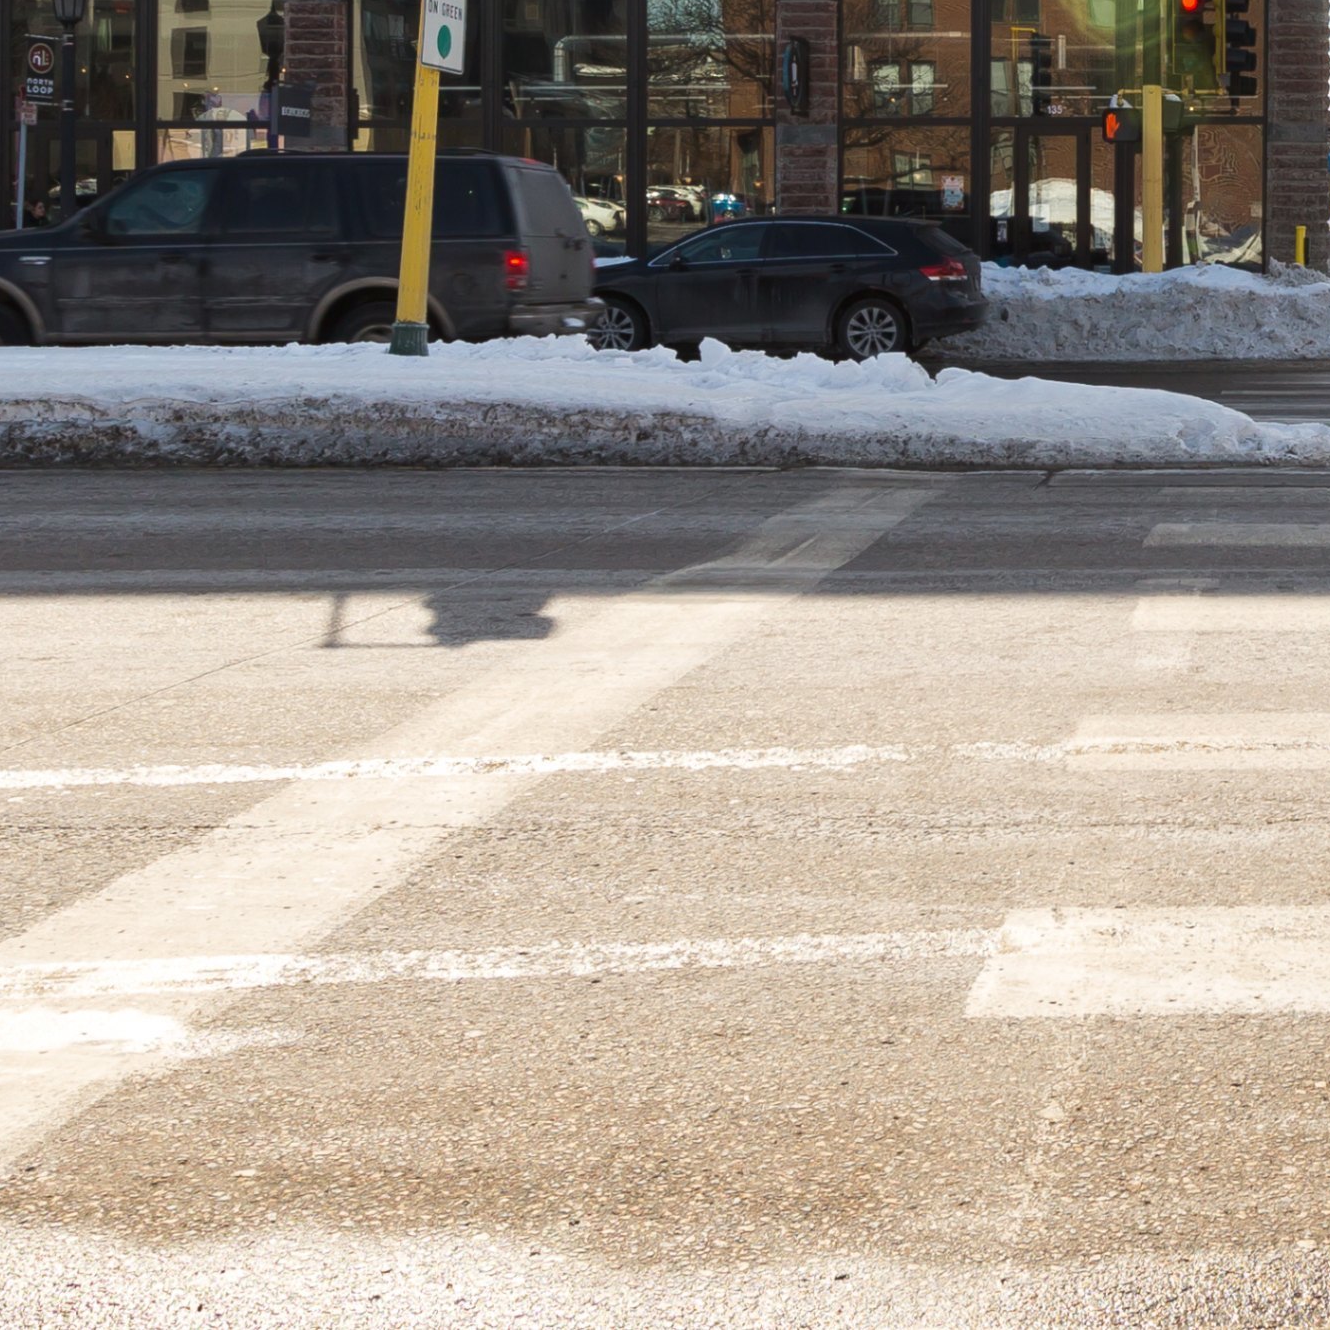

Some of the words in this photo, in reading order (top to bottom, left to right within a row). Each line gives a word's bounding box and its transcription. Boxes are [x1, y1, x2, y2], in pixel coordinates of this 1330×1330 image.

[441, 2, 463, 21] GREEN
[26, 85, 54, 95] LOOP
[1047, 104, 1063, 115] 135
